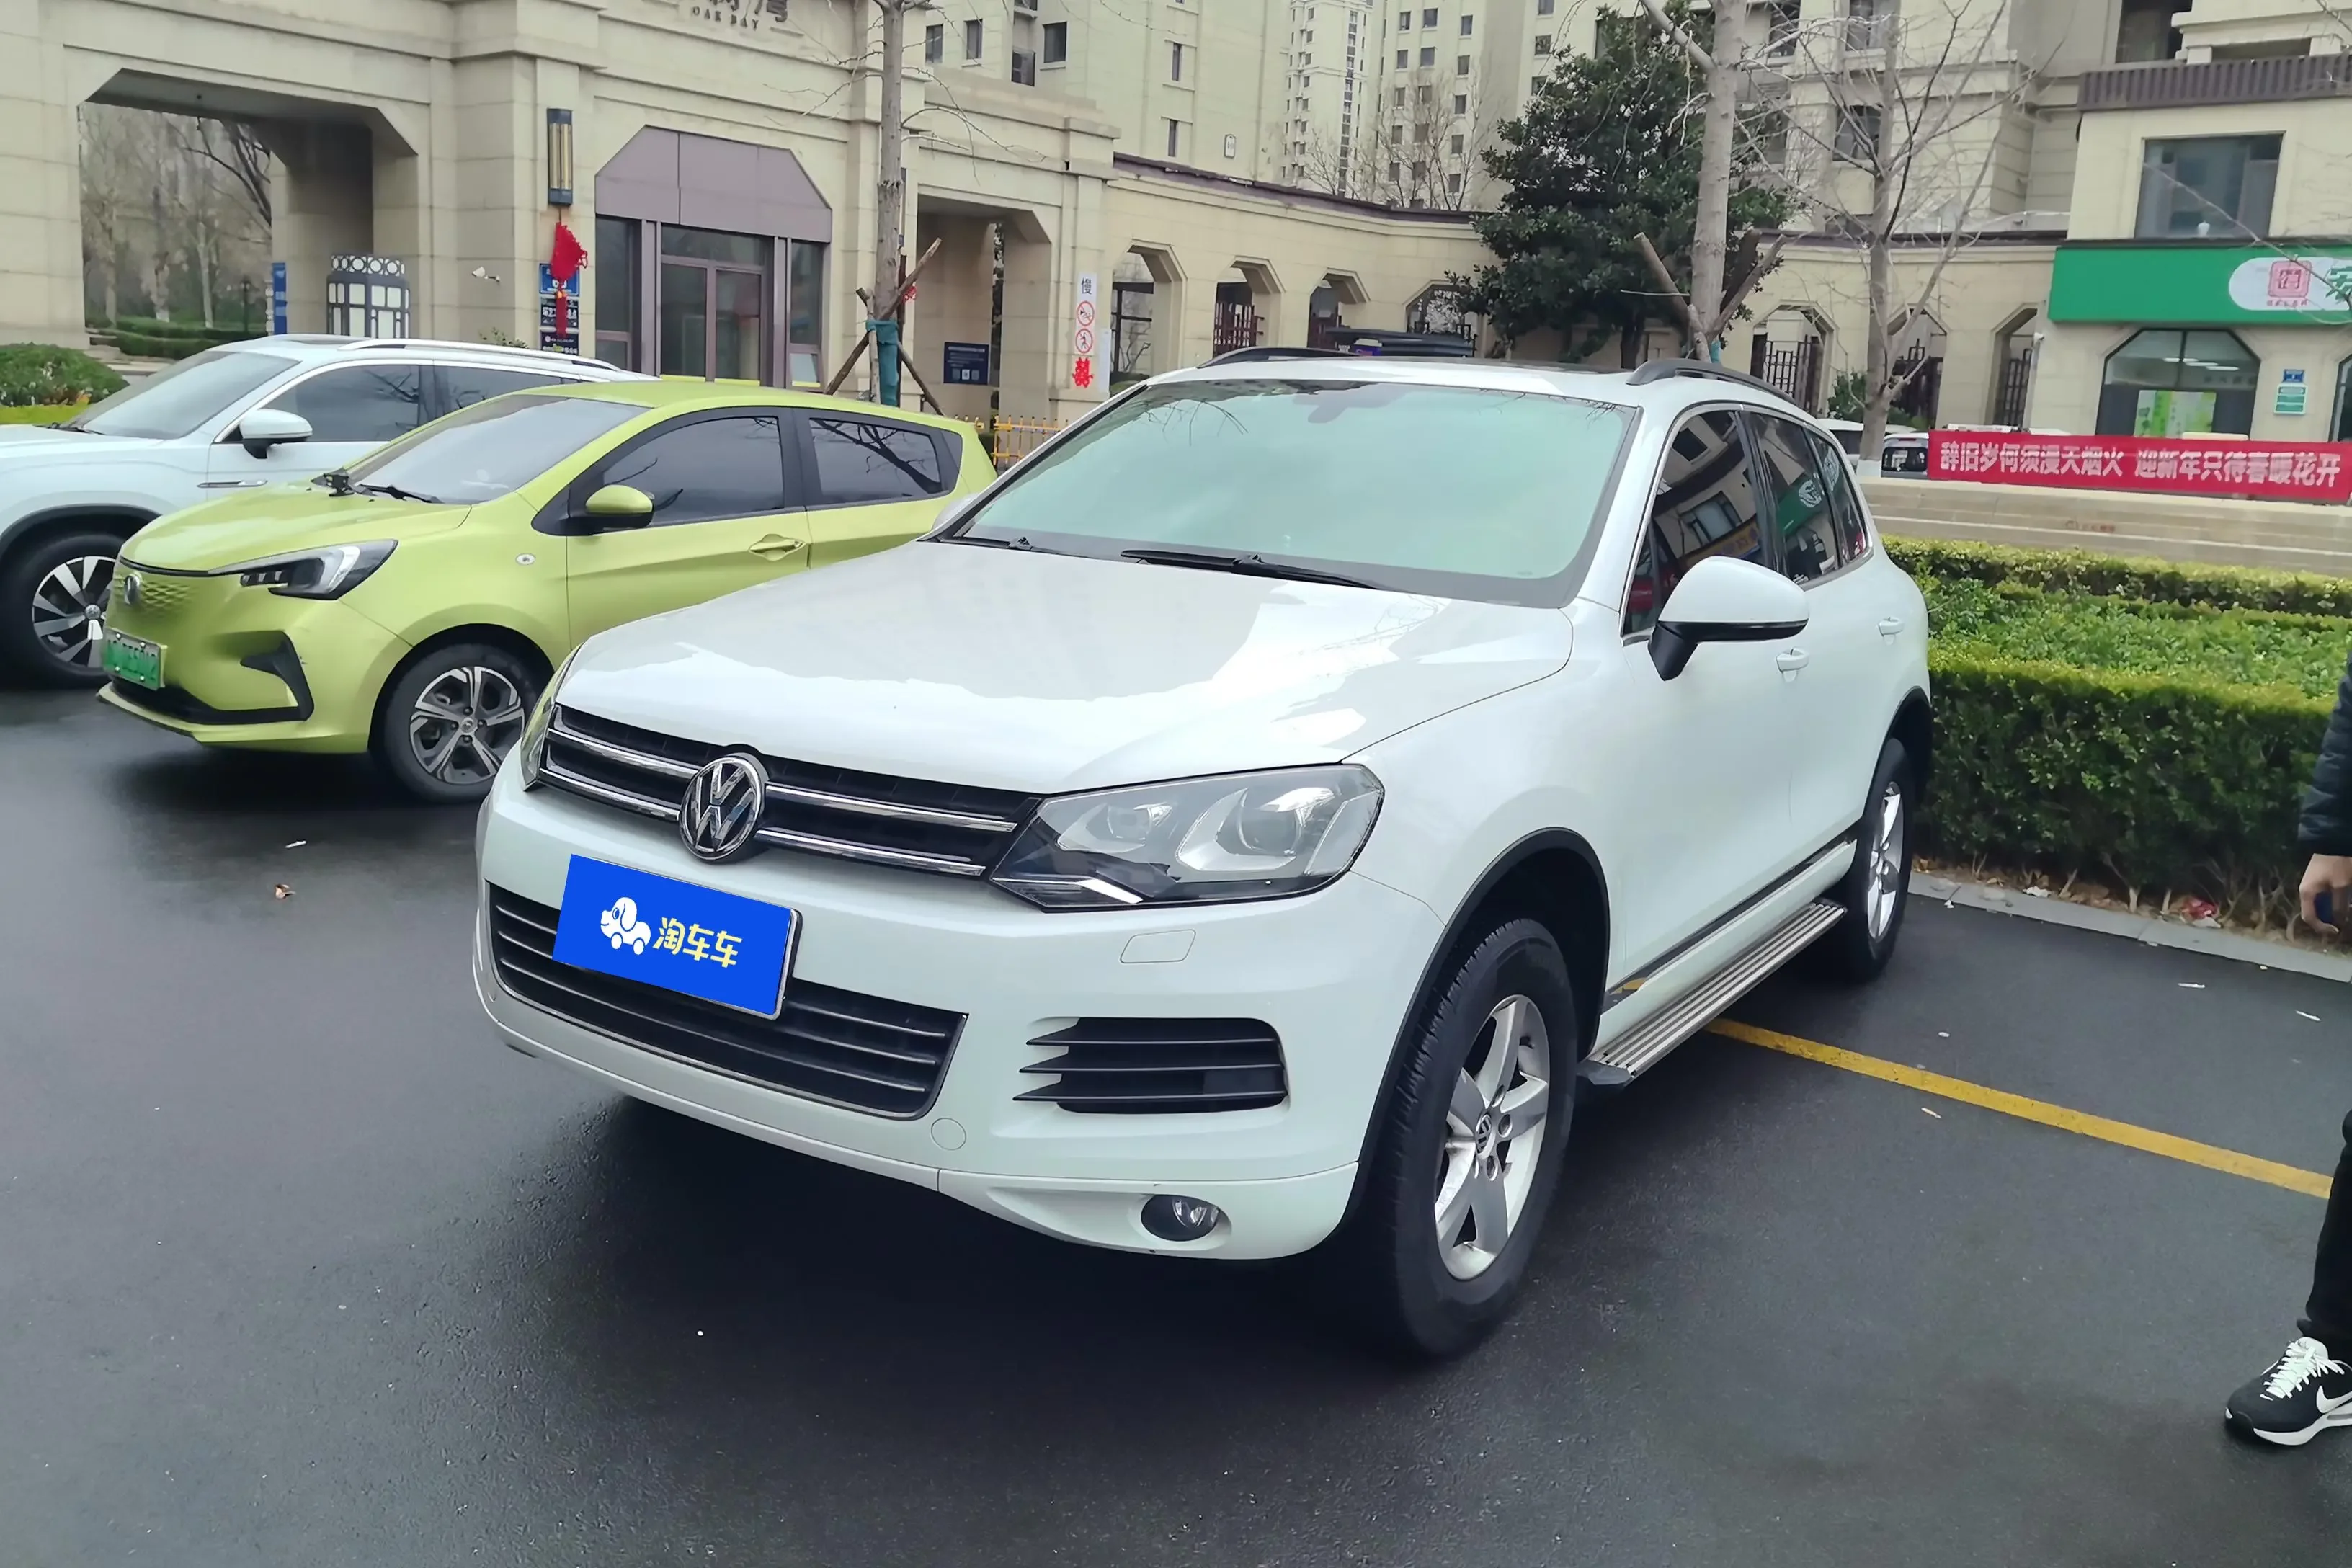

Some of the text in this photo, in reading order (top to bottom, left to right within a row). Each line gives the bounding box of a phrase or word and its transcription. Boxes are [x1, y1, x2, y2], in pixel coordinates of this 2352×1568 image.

[692, 6, 758, 31] OAK BAY
[1081, 277, 1092, 295] 慢
[1941, 441, 2341, 487] 辞旧岁何须漫天烟火 迎新年只待春暖花开
